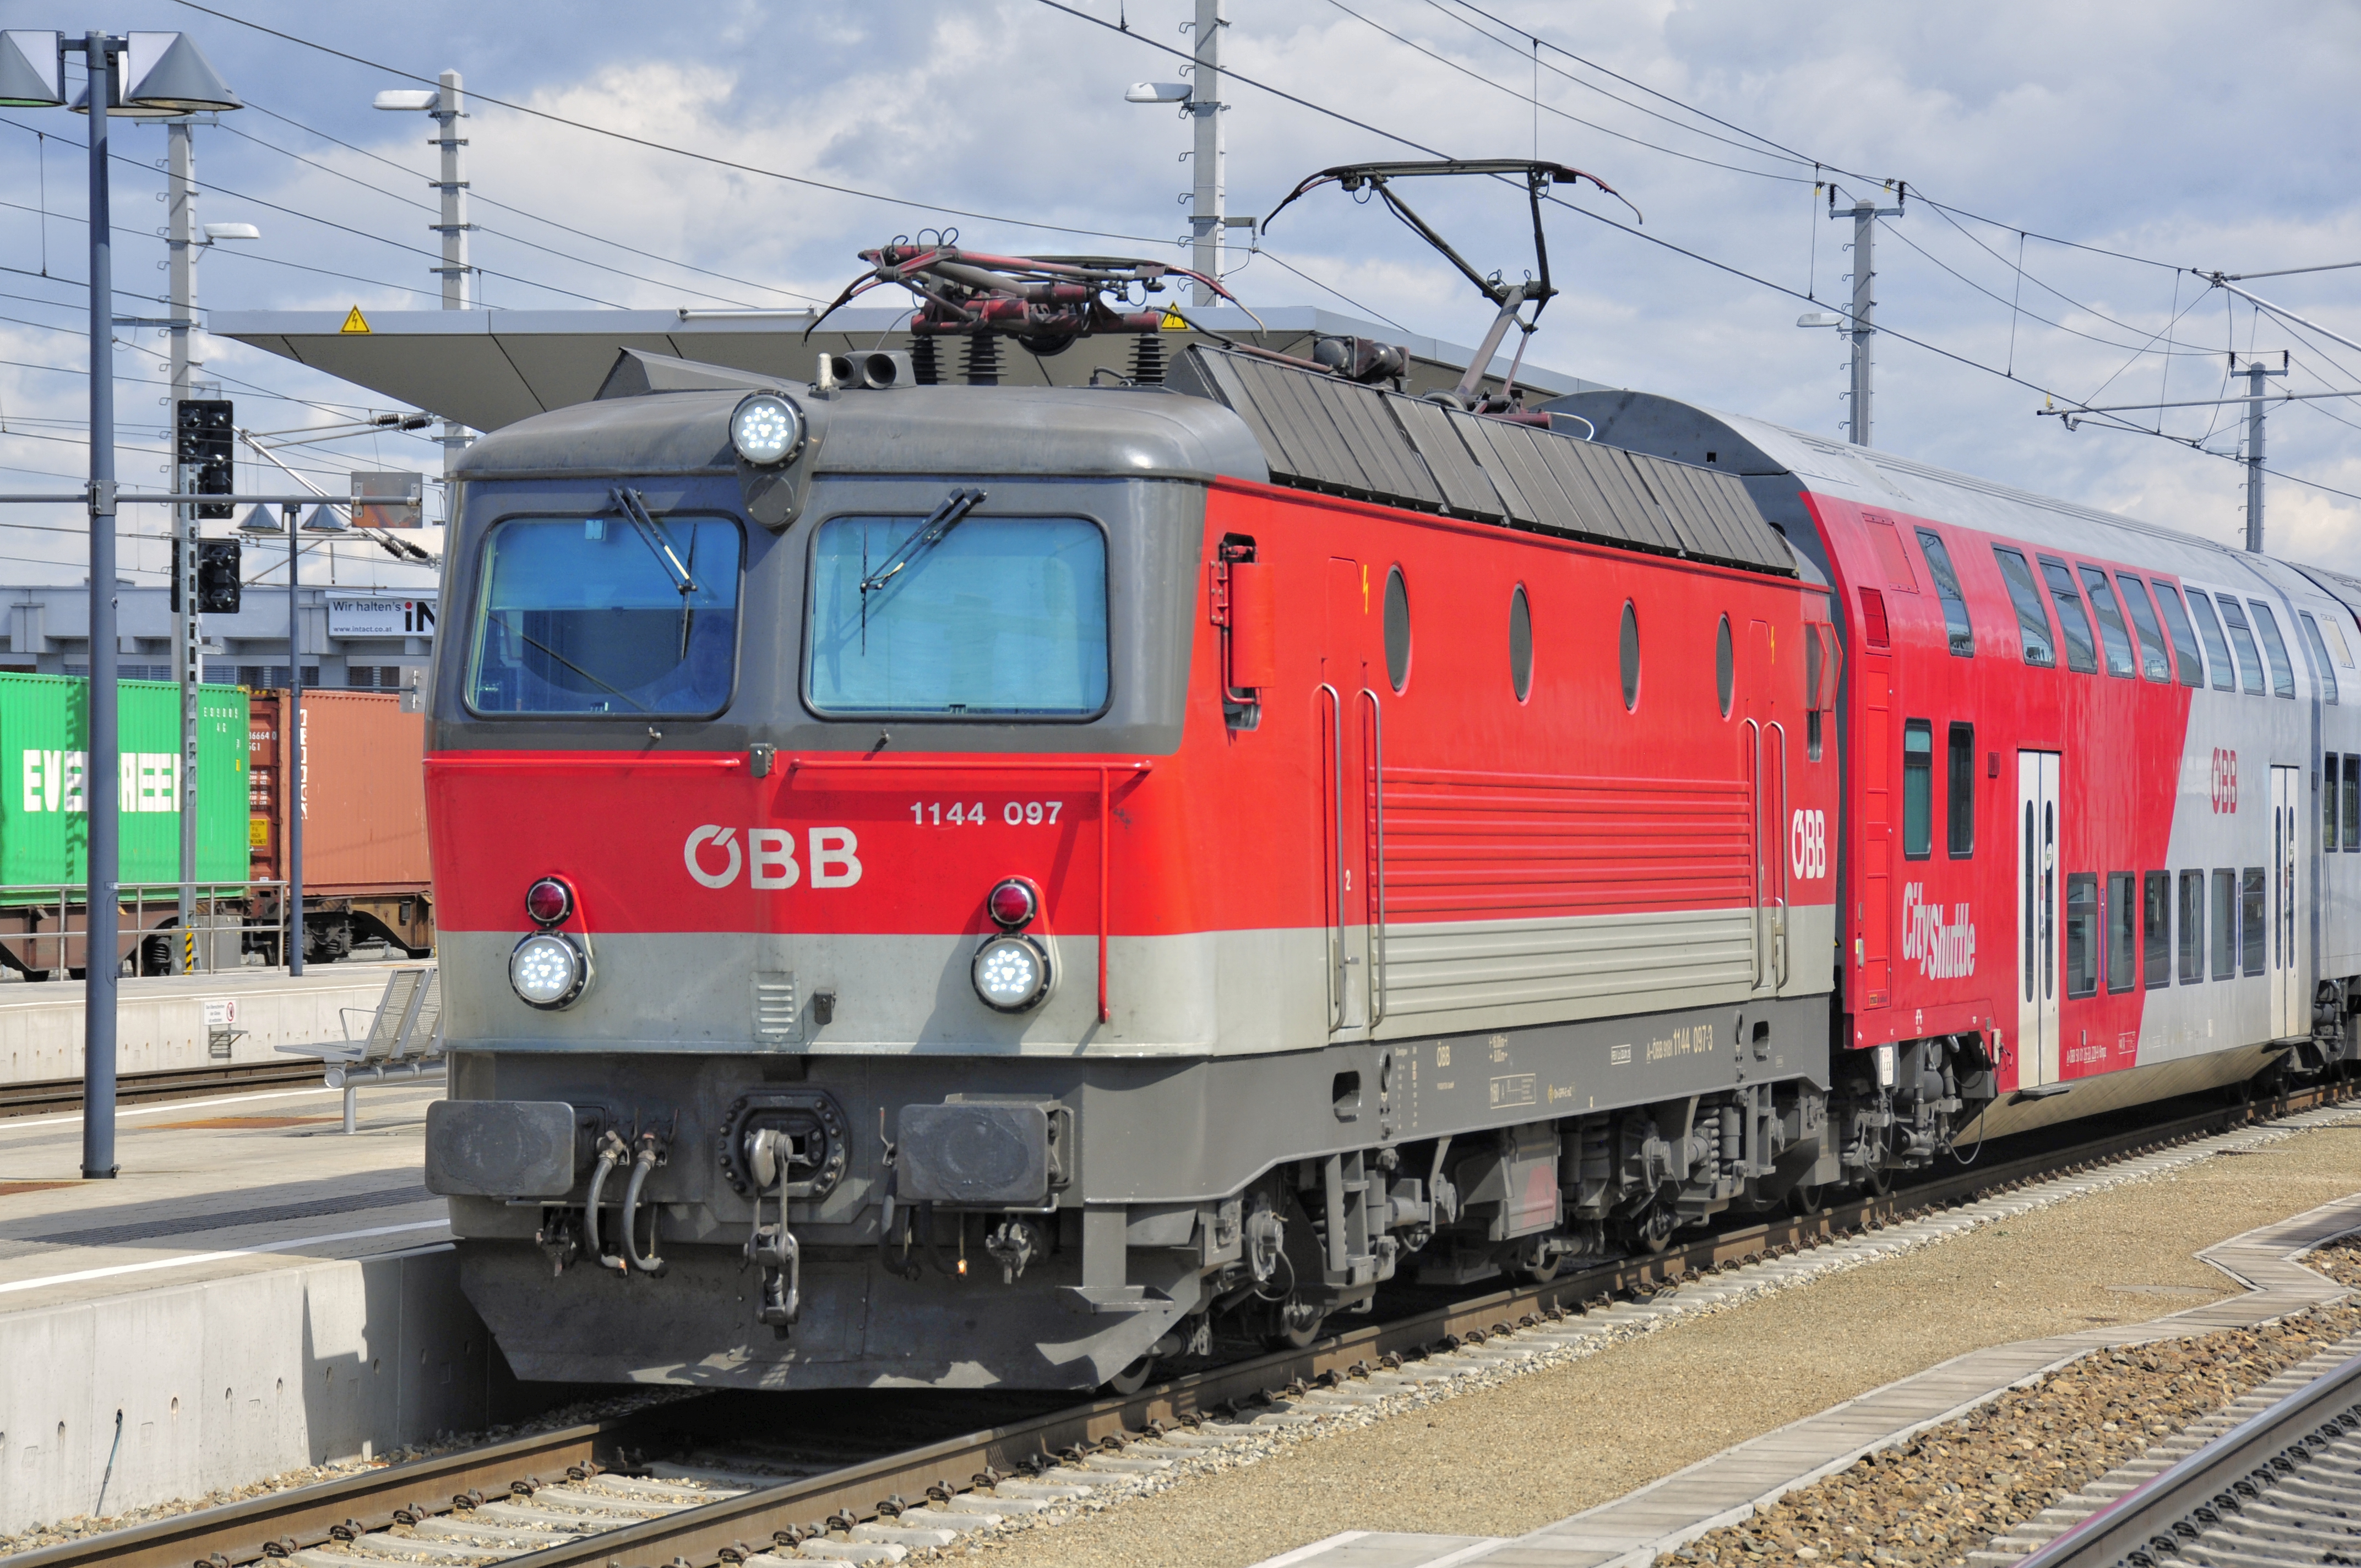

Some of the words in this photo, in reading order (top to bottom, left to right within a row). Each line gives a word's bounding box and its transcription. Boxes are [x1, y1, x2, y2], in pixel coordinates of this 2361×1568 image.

[333, 601, 352, 612] Wir
[356, 601, 401, 612] halten's
[2211, 747, 2237, 814] ÖBB
[910, 801, 986, 826] 1144
[1004, 801, 1063, 825] 097
[684, 824, 863, 890] ÖBB
[1792, 809, 1825, 880] ÖBB
[1673, 1027, 1690, 1056] 1144
